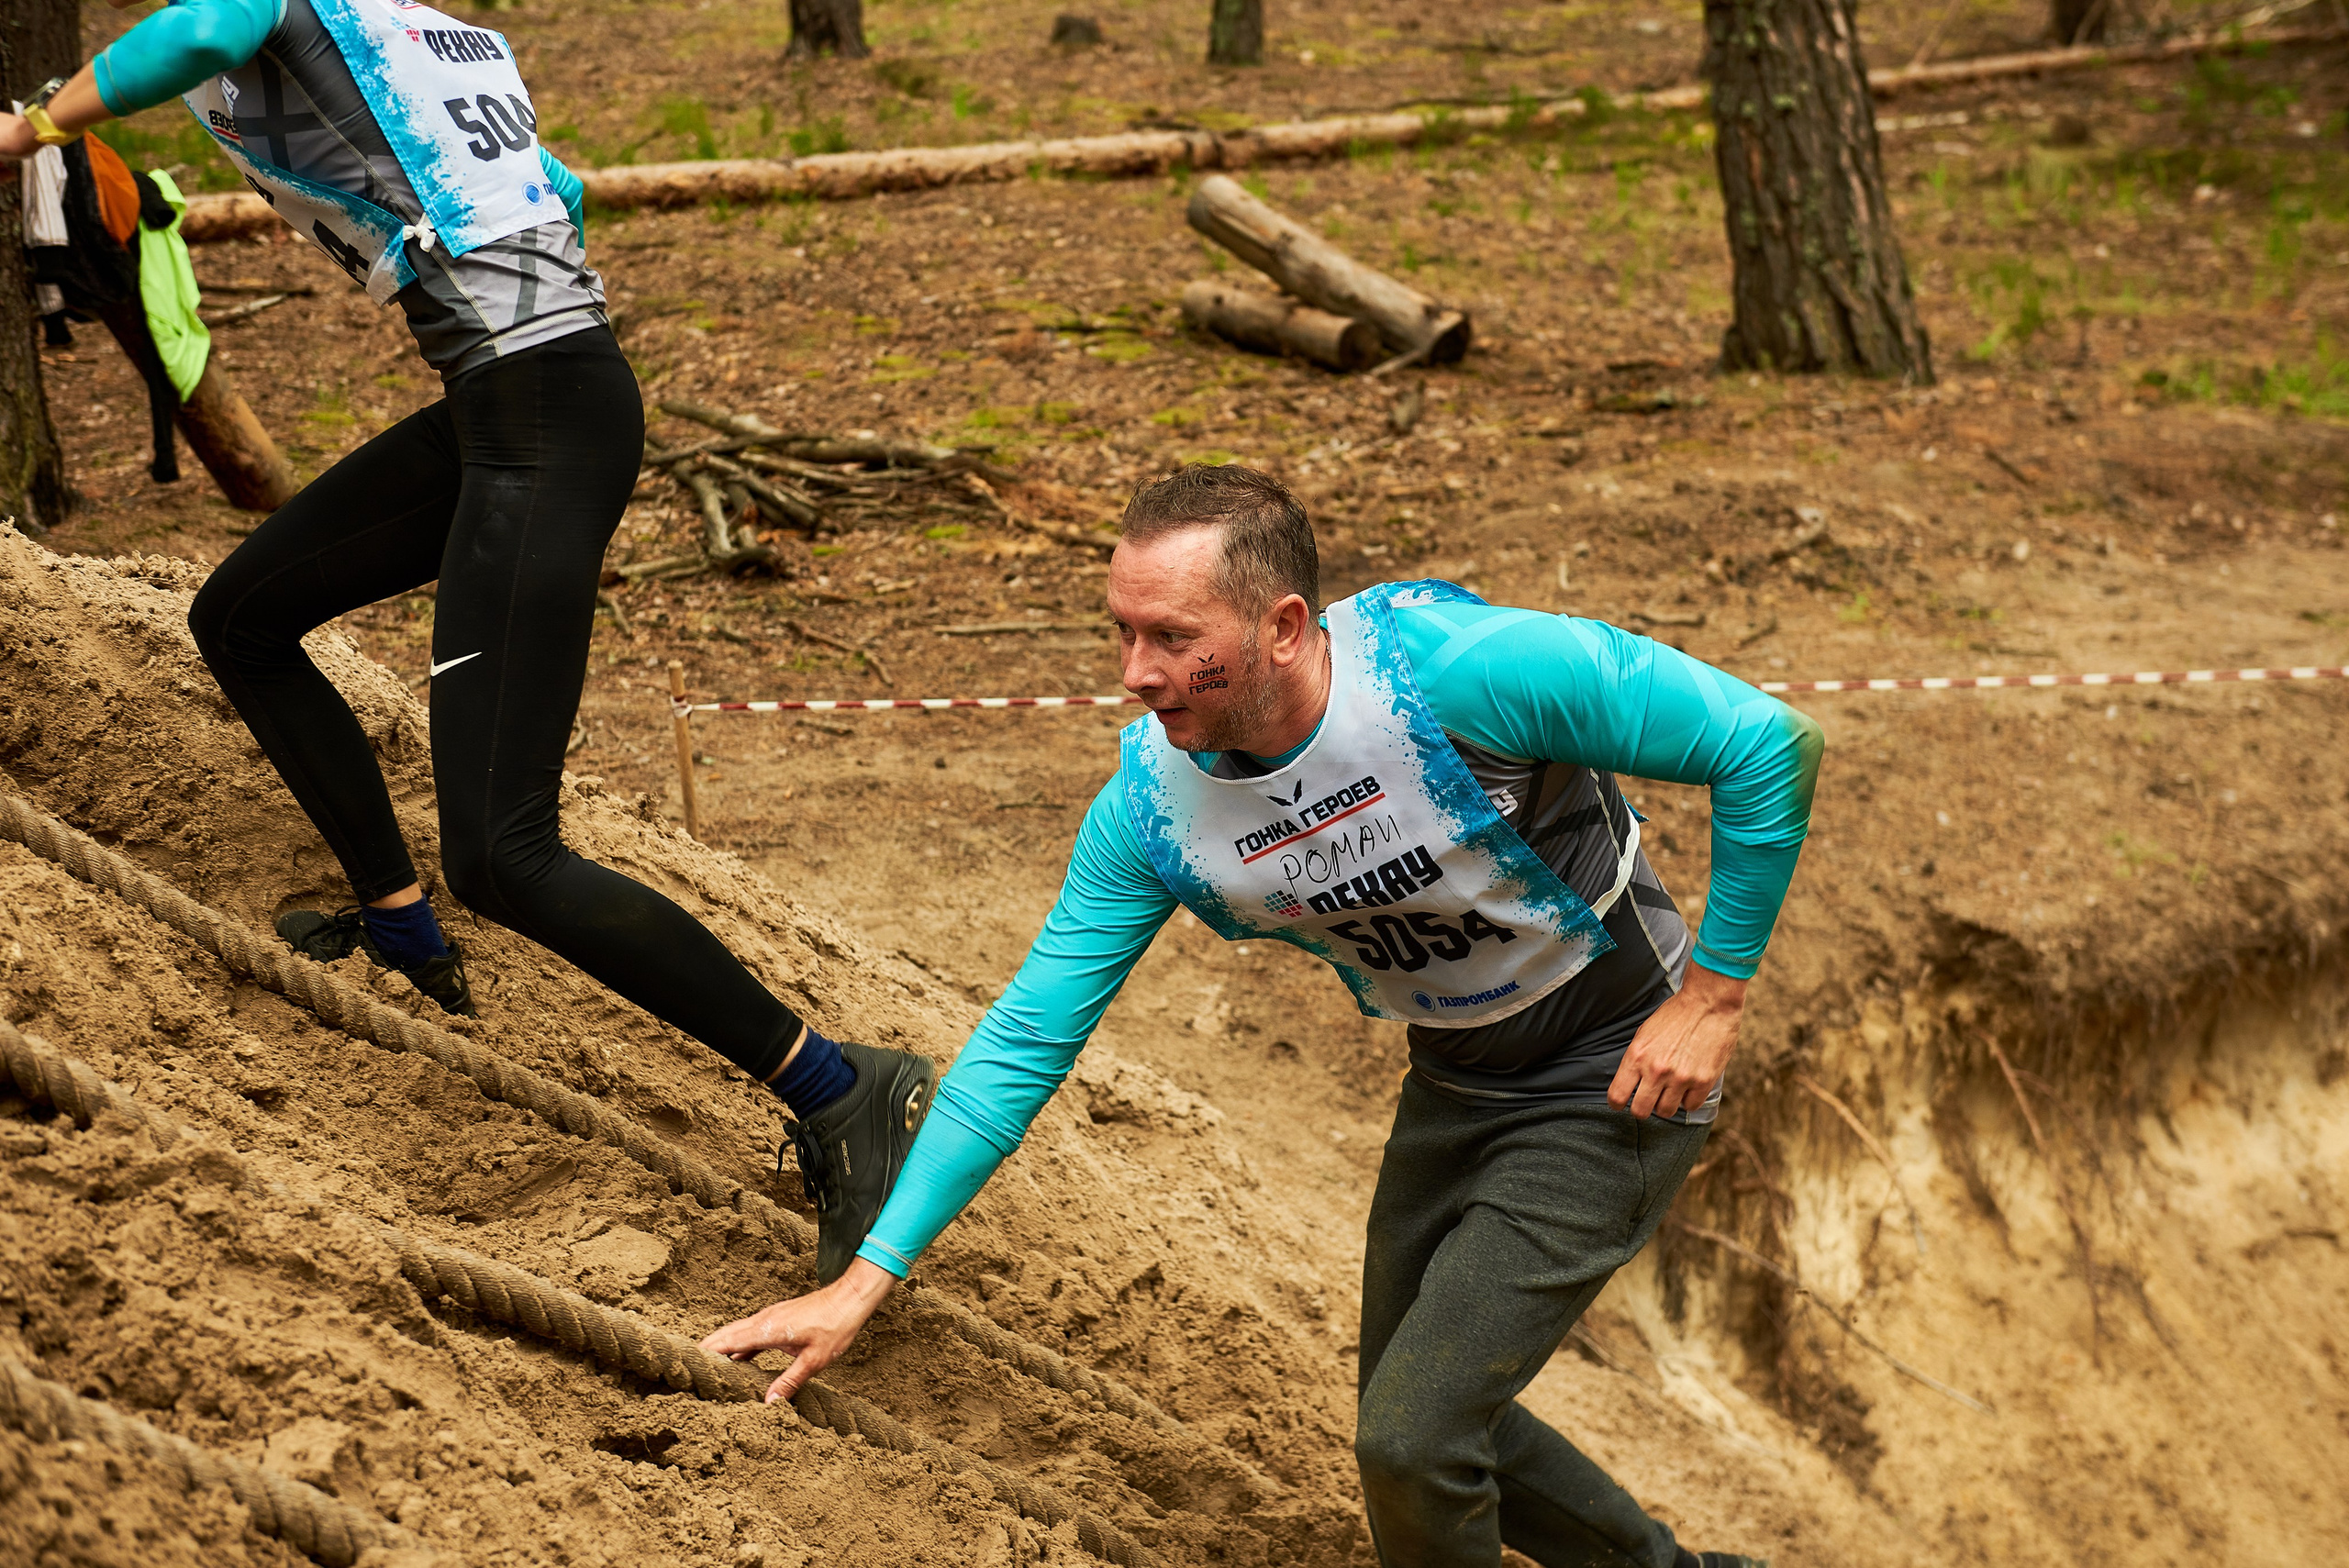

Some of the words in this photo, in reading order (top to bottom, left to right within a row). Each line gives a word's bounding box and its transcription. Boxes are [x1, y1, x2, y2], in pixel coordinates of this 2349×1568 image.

[443, 94, 537, 161] 504
[1189, 680, 1229, 695] ГЕРОЕВ
[1190, 665, 1225, 682] ГОНКА
[1234, 819, 1301, 858] ГОНКА
[1298, 775, 1381, 828] ГЕРОЕВ
[1325, 909, 1518, 973] 5054
[1437, 980, 1520, 1008] ГАЗПРОМБАНК
